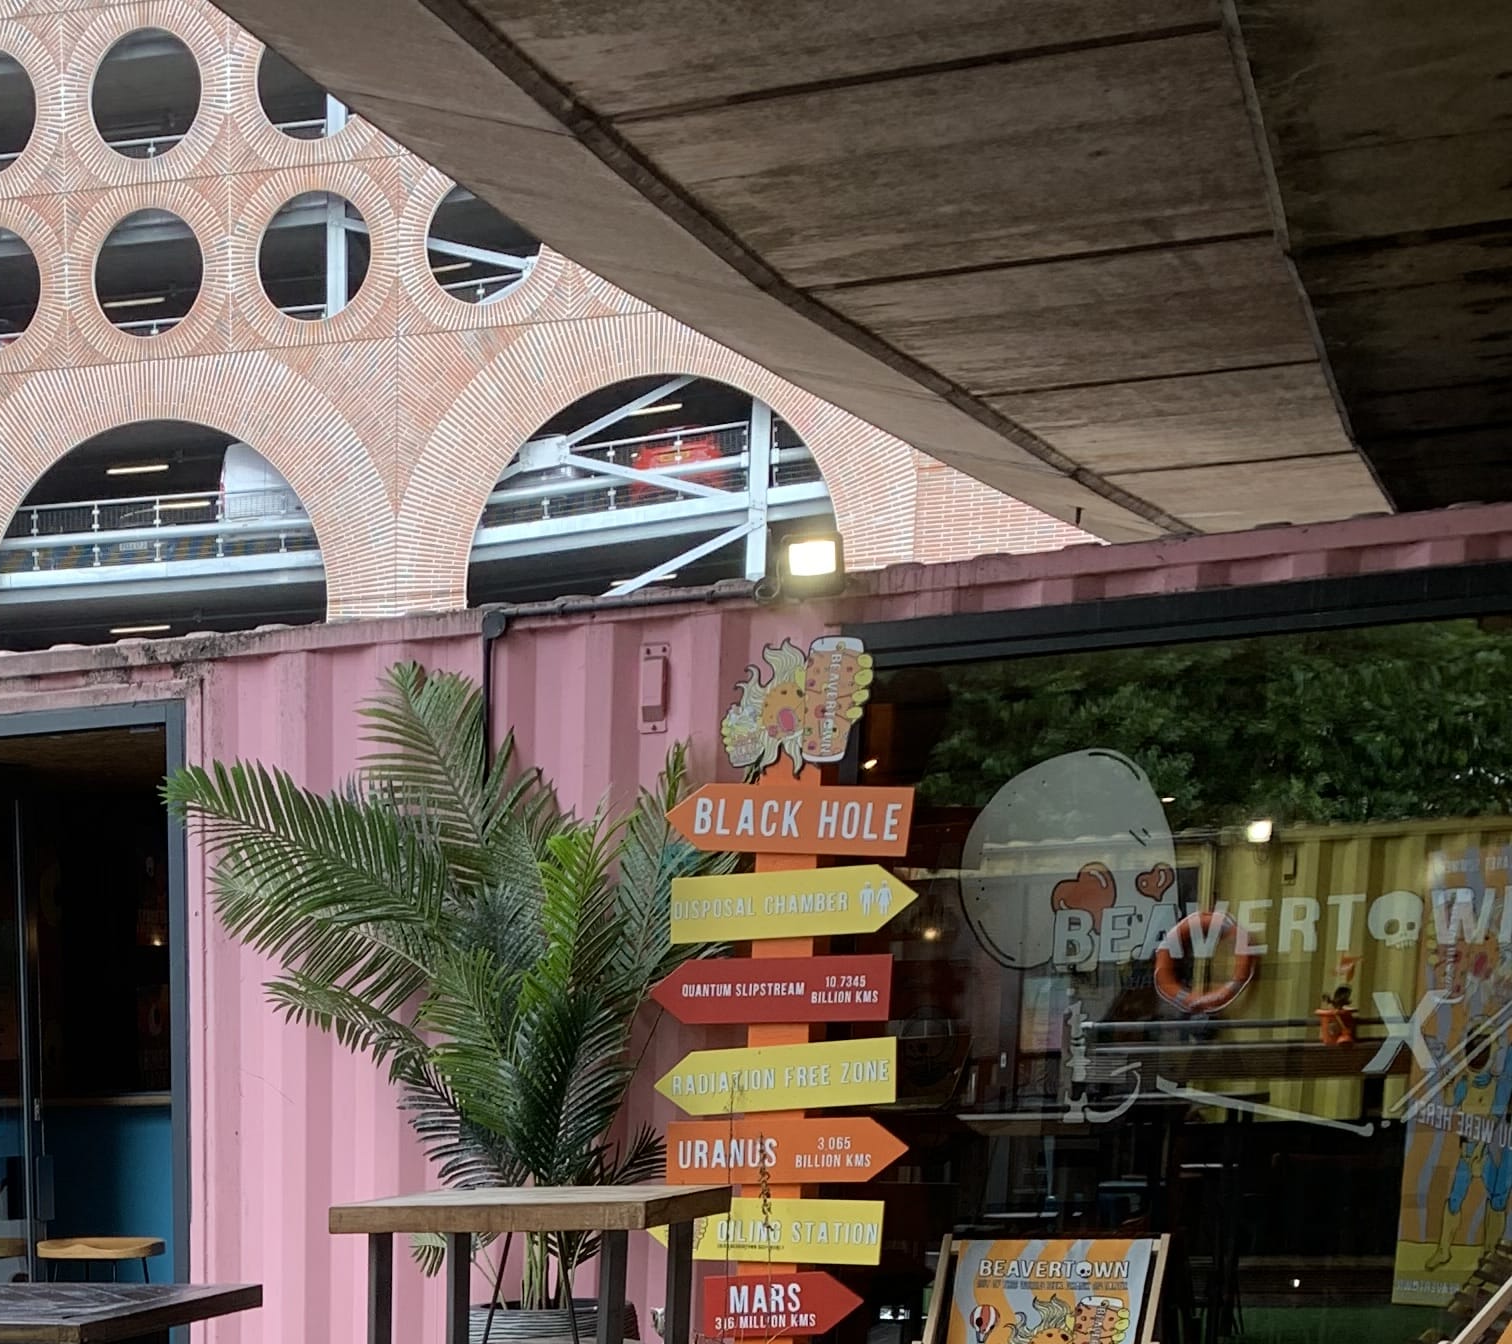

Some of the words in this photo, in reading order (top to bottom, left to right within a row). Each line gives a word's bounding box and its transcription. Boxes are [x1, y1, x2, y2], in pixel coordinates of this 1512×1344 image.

[693, 797, 804, 839] BLACK
[817, 801, 903, 842] HOLE
[673, 897, 757, 921] DISPOSAL
[764, 891, 849, 916] CHAMBER
[681, 984, 732, 998] QUANTUM
[735, 981, 805, 997] SLIPSTREAM
[811, 991, 852, 1004] BILLION
[855, 990, 879, 1003] KMS
[1362, 990, 1464, 1074] X
[671, 1068, 776, 1096] RADIATION
[784, 1063, 831, 1088] FREE
[840, 1059, 890, 1083] ZONE
[678, 1138, 778, 1169] URANUS
[795, 1154, 841, 1168] BILLION
[845, 1153, 872, 1168] KMS
[791, 1221, 879, 1246] STATION
[978, 1259, 1130, 1280] BEAVERTOWN
[728, 1283, 802, 1315] MARS
[739, 1315, 786, 1329] MILLION
[790, 1313, 816, 1328] KMS
